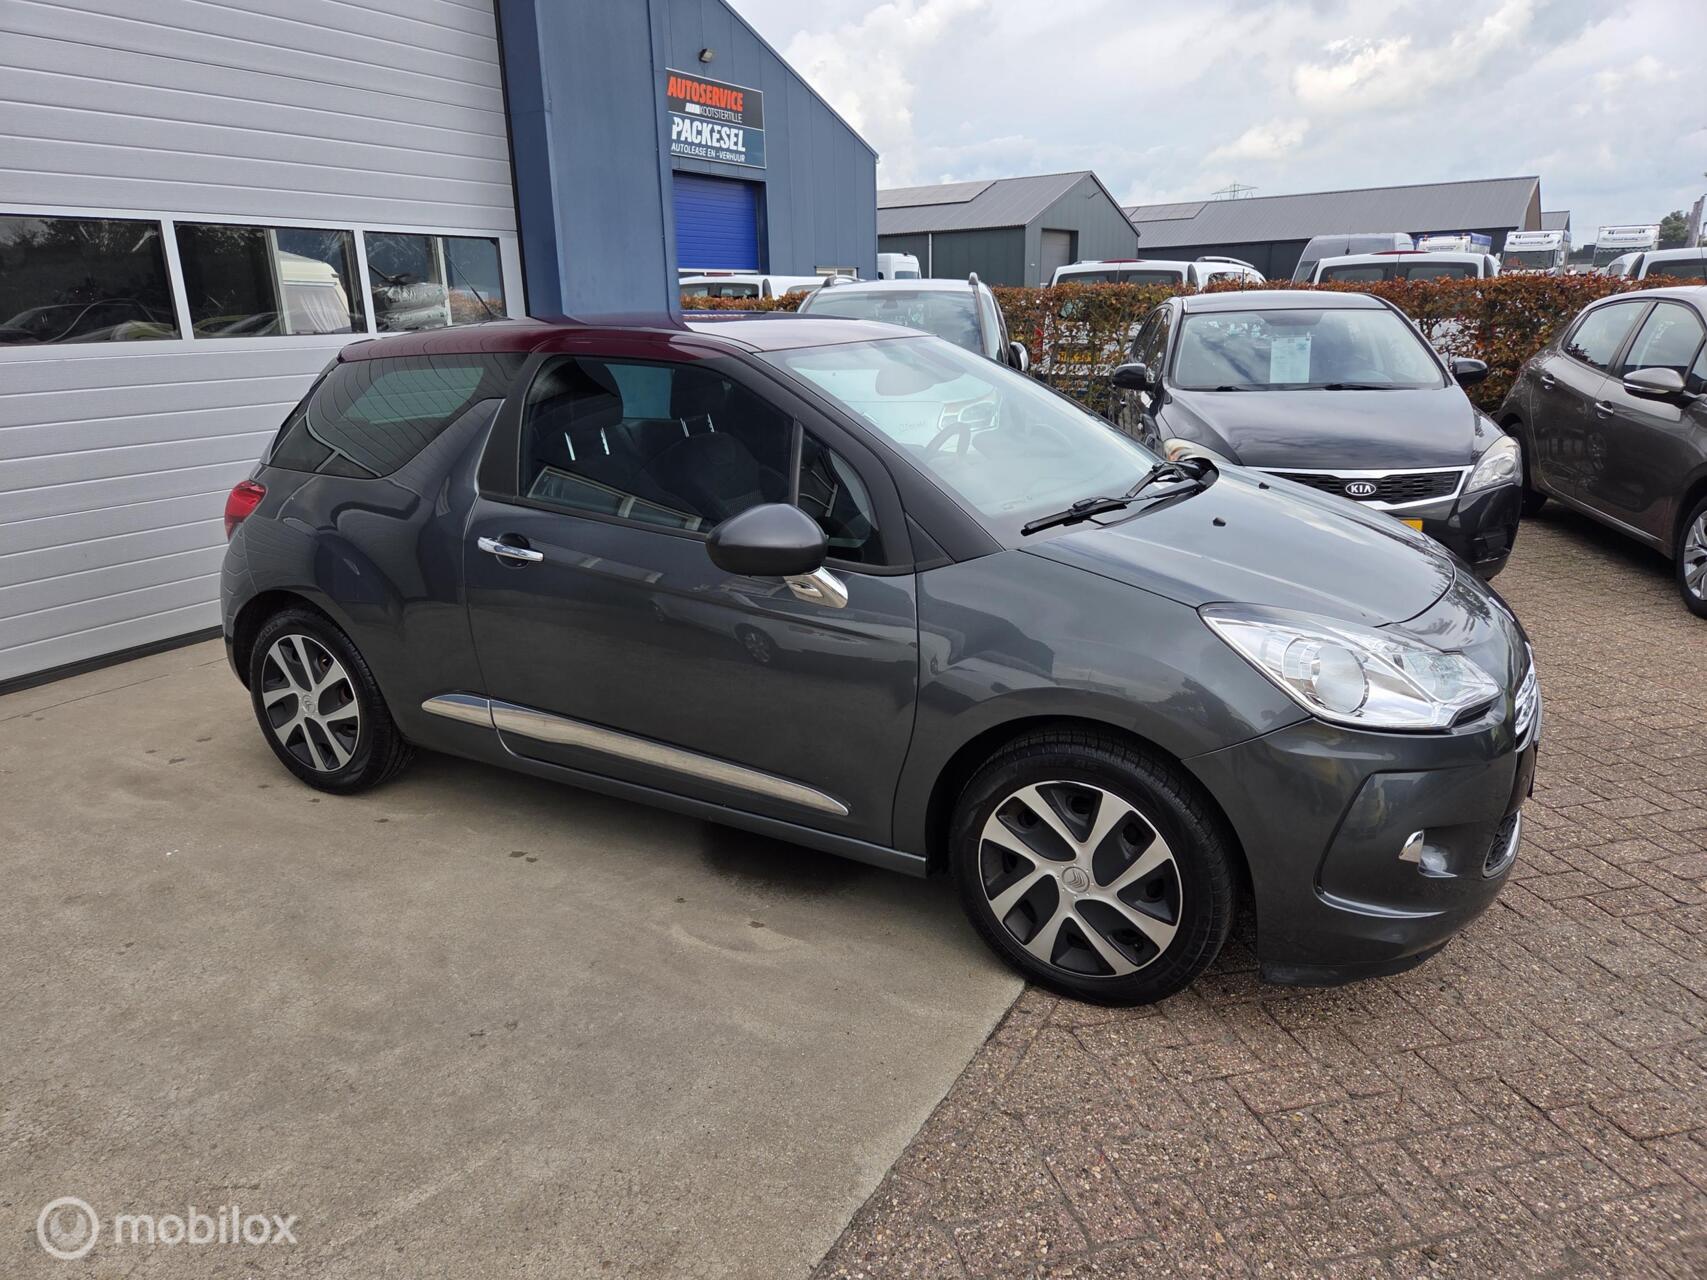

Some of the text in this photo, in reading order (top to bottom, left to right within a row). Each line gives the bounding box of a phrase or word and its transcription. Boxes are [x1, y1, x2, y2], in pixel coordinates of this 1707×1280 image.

[667, 76, 744, 112] AUTOSERVICE
[671, 116, 746, 152] PACKESEL
[671, 142, 707, 156] AUTOLEASE
[707, 148, 716, 158] EN
[1350, 484, 1371, 493] KIA
